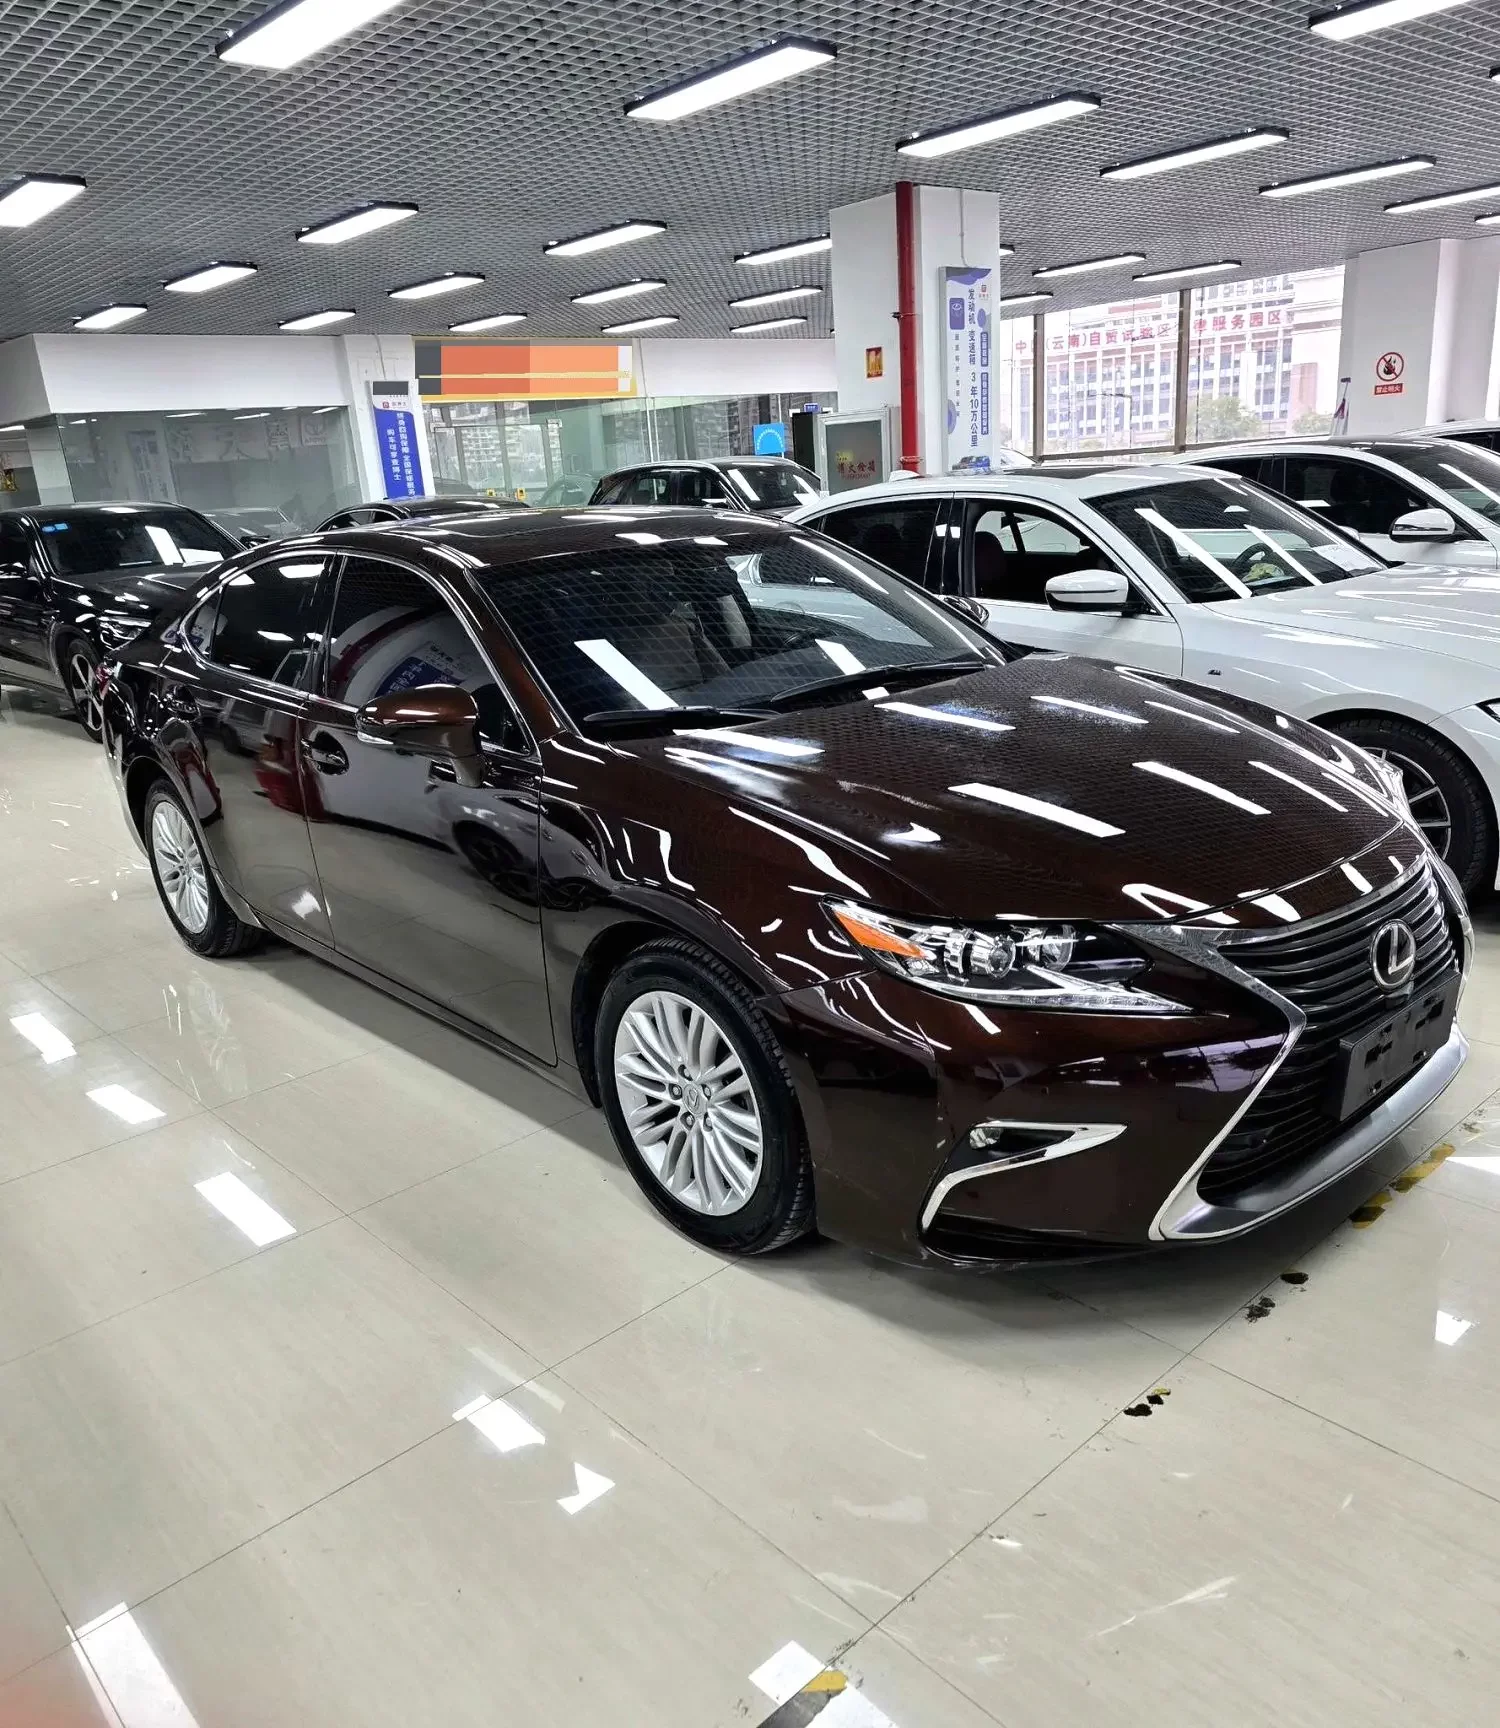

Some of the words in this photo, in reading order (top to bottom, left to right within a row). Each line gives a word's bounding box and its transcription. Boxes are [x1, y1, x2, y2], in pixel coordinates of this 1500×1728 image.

[968, 288, 977, 325] 发动机
[1015, 310, 1281, 355] 中(云南)自贸试验区律服务园区
